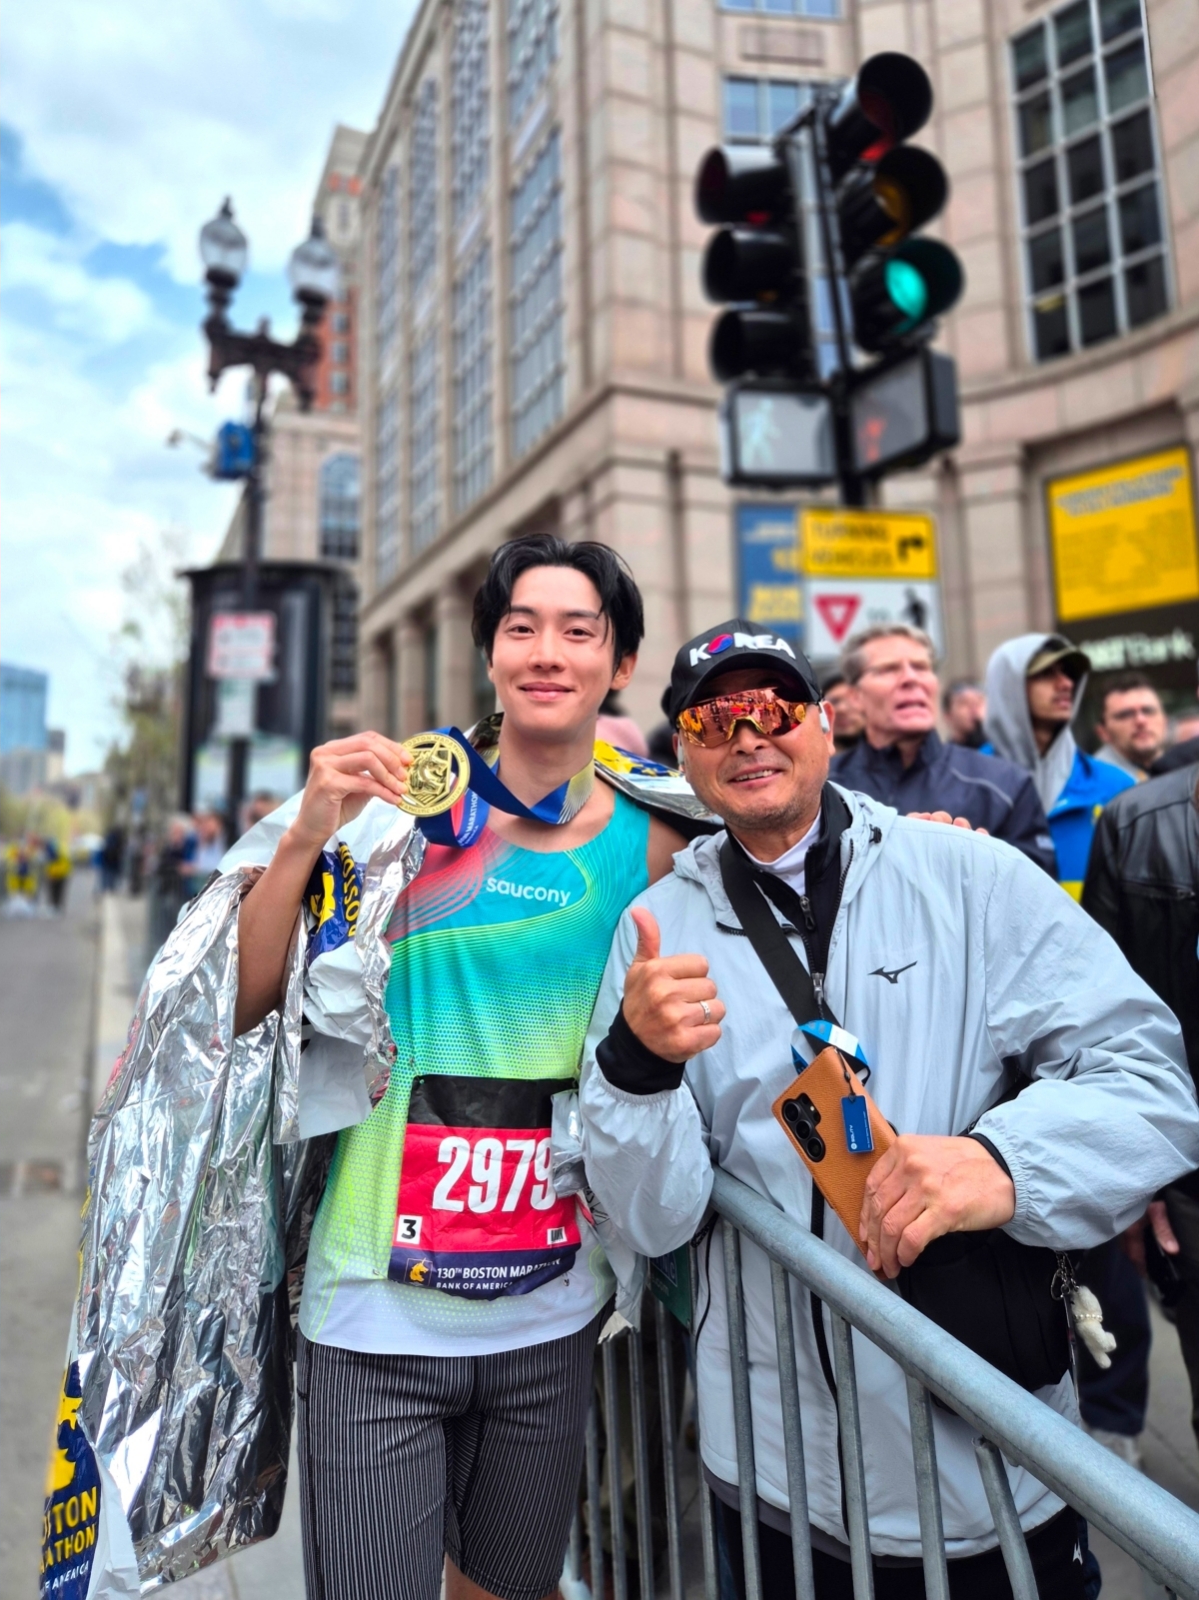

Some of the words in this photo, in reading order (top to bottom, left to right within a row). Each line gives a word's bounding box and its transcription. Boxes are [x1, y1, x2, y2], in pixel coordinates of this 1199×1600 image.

[689, 632, 796, 667] KOREA
[486, 877, 571, 907] saucony
[431, 1136, 557, 1214] 2979
[401, 1218, 417, 1240] 3
[462, 1266, 507, 1279] BOSTON
[436, 1282, 461, 1290] BANK
[462, 1282, 474, 1290] OF
